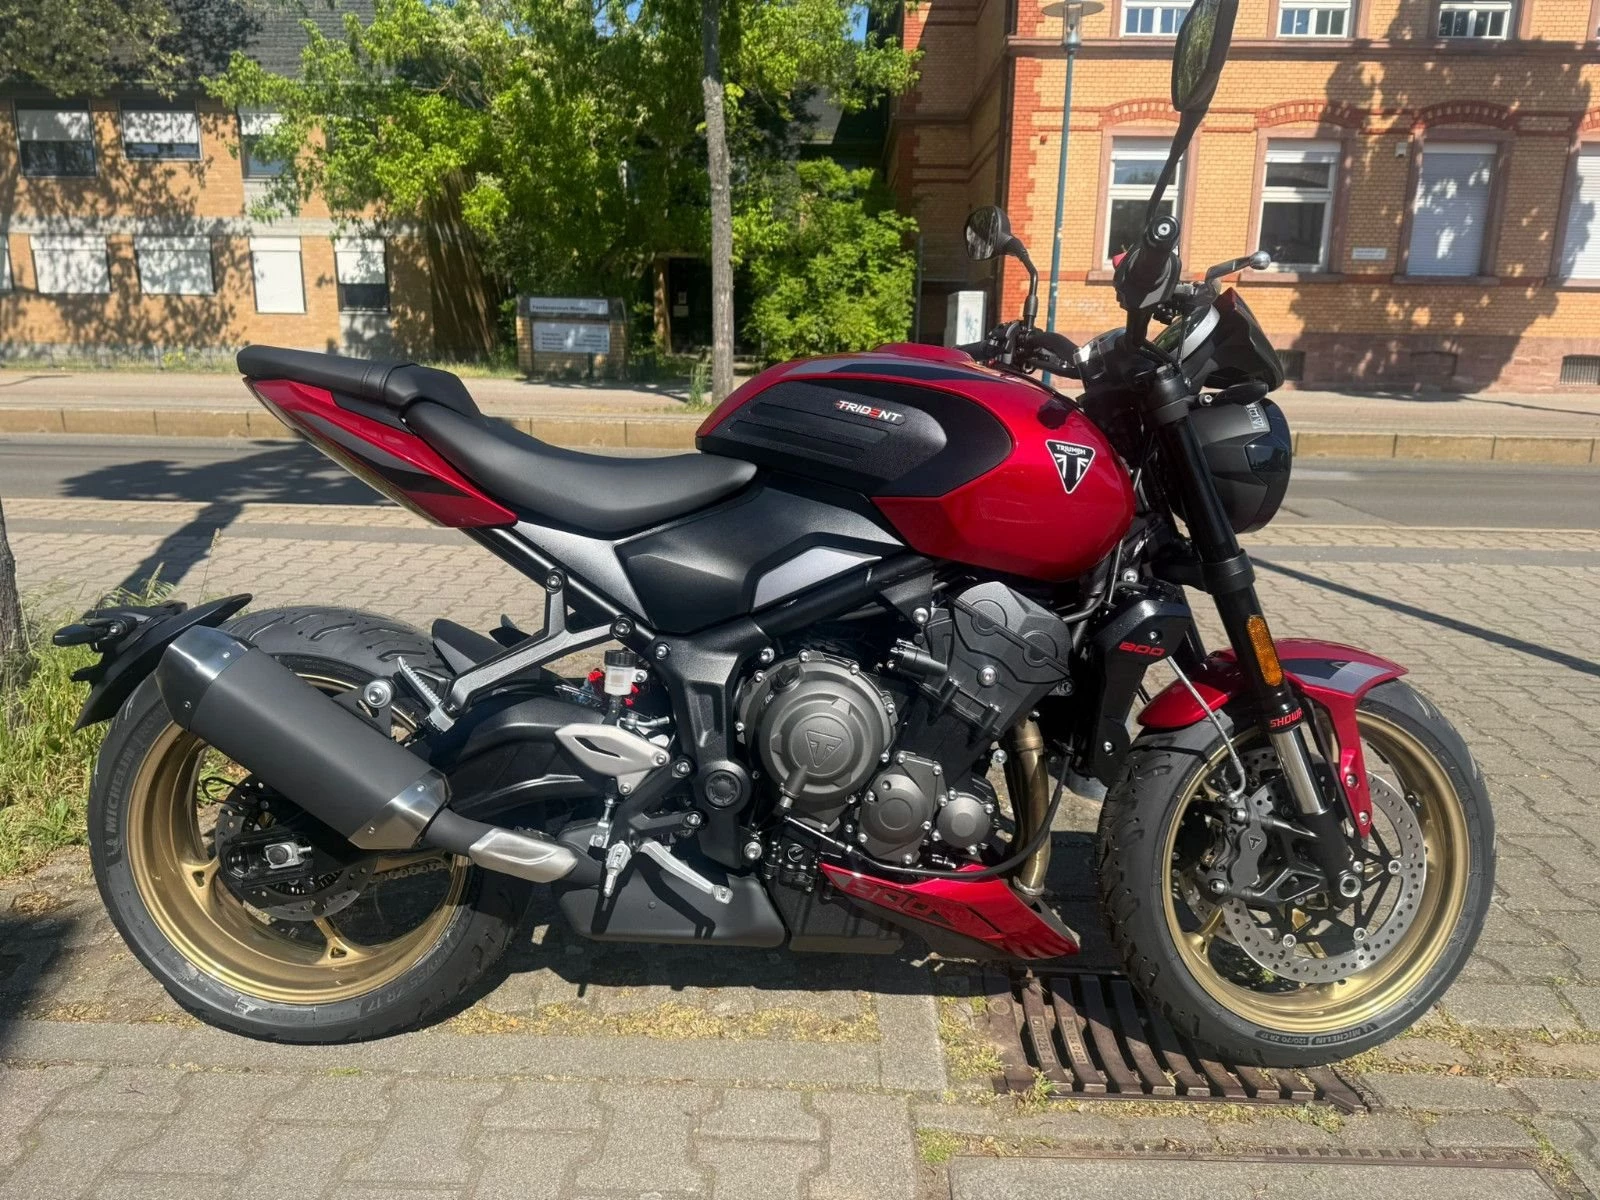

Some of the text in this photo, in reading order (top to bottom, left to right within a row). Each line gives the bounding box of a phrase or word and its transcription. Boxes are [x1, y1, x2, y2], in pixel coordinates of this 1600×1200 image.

[834, 400, 902, 421] TRIDENT
[1055, 444, 1086, 455] TRIUMPH
[1119, 641, 1165, 656] 800
[1270, 707, 1303, 727] SHOWA
[105, 747, 135, 833] MICHELIN
[367, 997, 381, 1012] 17
[1280, 1036, 1307, 1045] 120/70
[1315, 1028, 1362, 1044] MICHELIN
